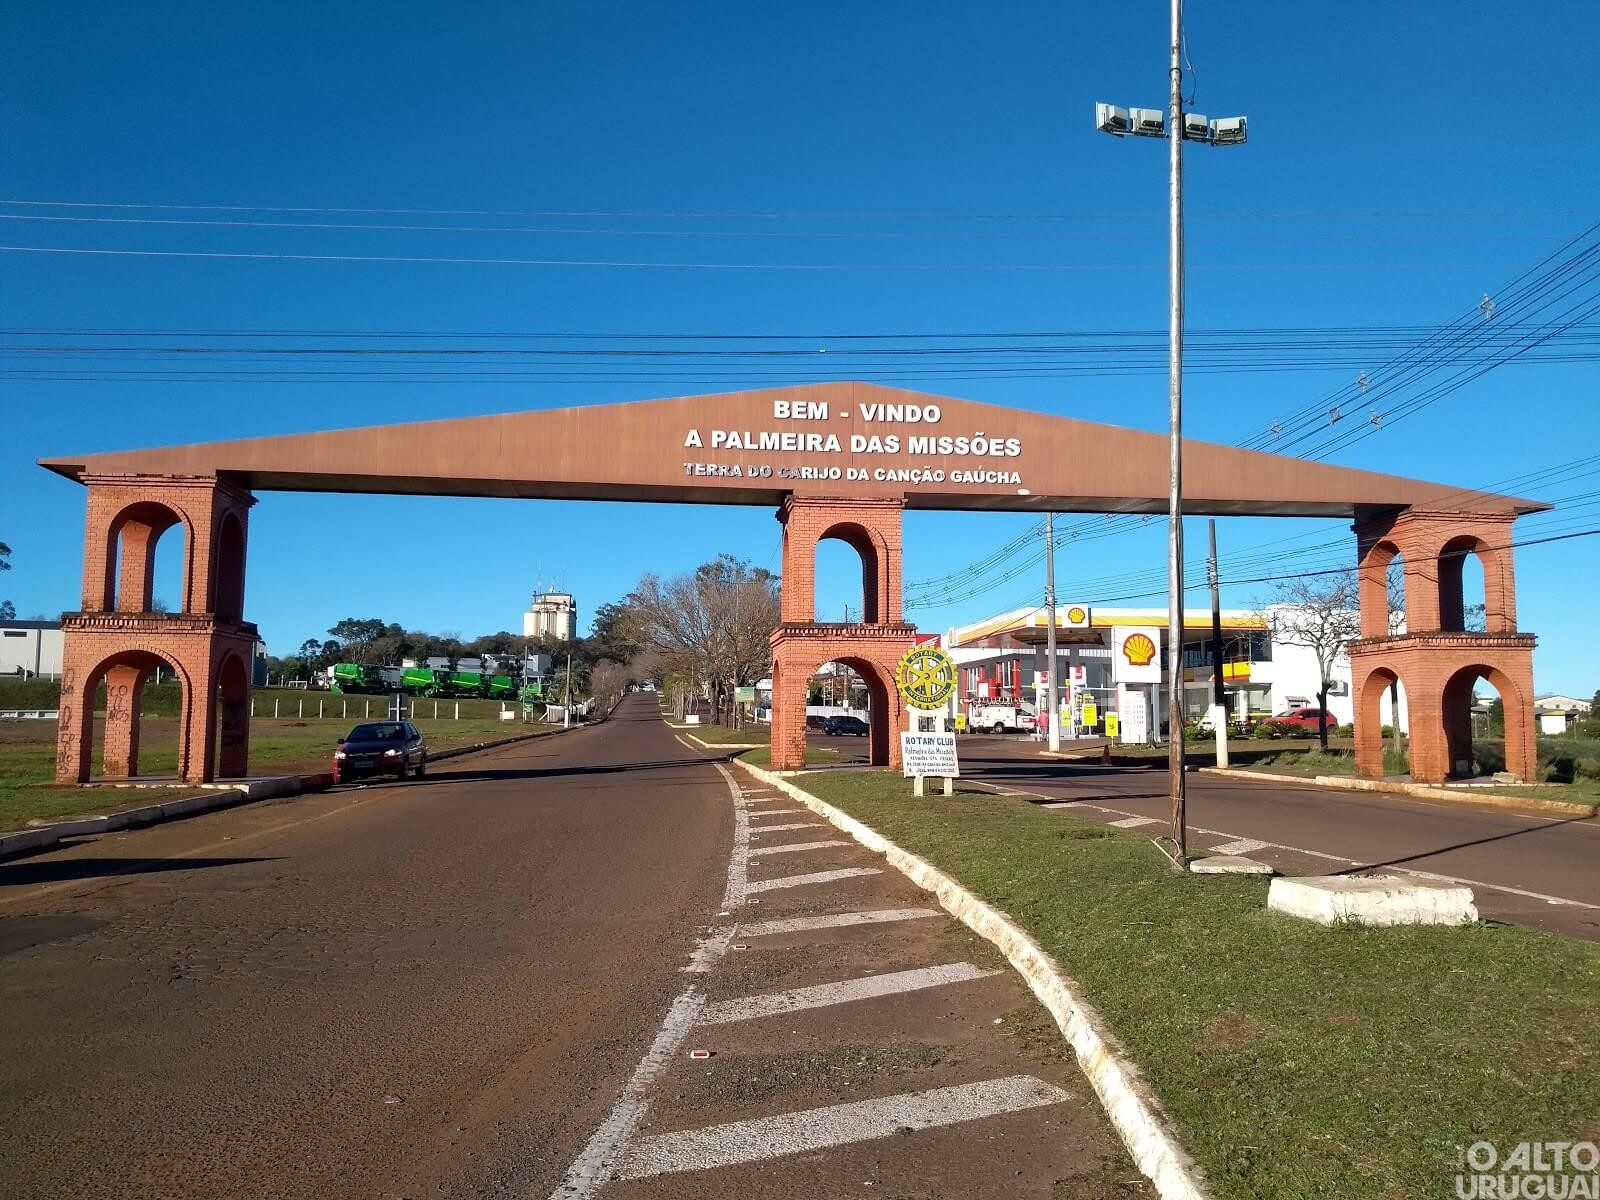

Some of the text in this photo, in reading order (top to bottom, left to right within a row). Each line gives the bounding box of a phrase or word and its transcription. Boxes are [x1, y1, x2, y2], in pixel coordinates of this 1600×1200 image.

[773, 400, 829, 420] BEM
[859, 402, 942, 424] VINDO
[683, 429, 1022, 458] A PALMEIRA DAS MISSÕES
[683, 462, 1023, 486] TERRA DO CARIJO DA CANÇÃO GAÚCHA
[910, 650, 938, 660] ROTARY
[907, 687, 949, 702] INTERNATIONAL
[905, 736, 954, 746] ROTARY CLUB
